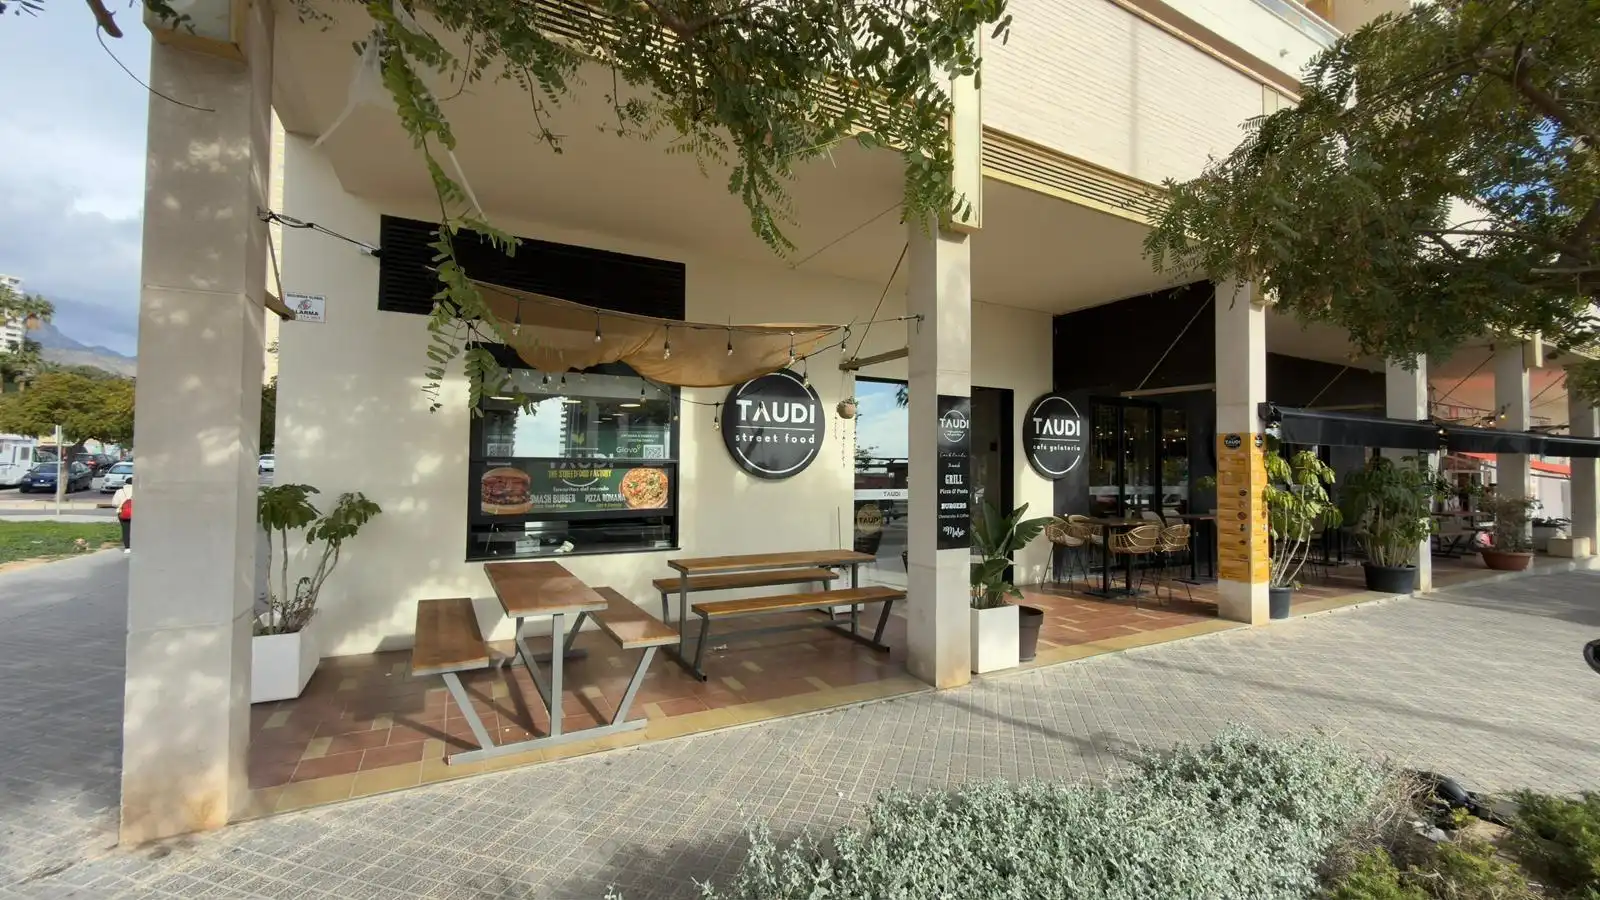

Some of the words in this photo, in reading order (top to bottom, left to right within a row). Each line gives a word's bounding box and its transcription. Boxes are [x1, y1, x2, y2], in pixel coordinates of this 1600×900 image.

[736, 400, 815, 424] TAUDI
[939, 418, 969, 429] TAUDI
[1033, 417, 1080, 437] TAUDI
[735, 433, 778, 443] street
[785, 433, 815, 444] food
[615, 446, 638, 454] Glovo
[1049, 445, 1081, 453] gelateria
[945, 474, 964, 485] GRILL
[552, 494, 576, 504] BURGER
[584, 494, 601, 503] PIZZA
